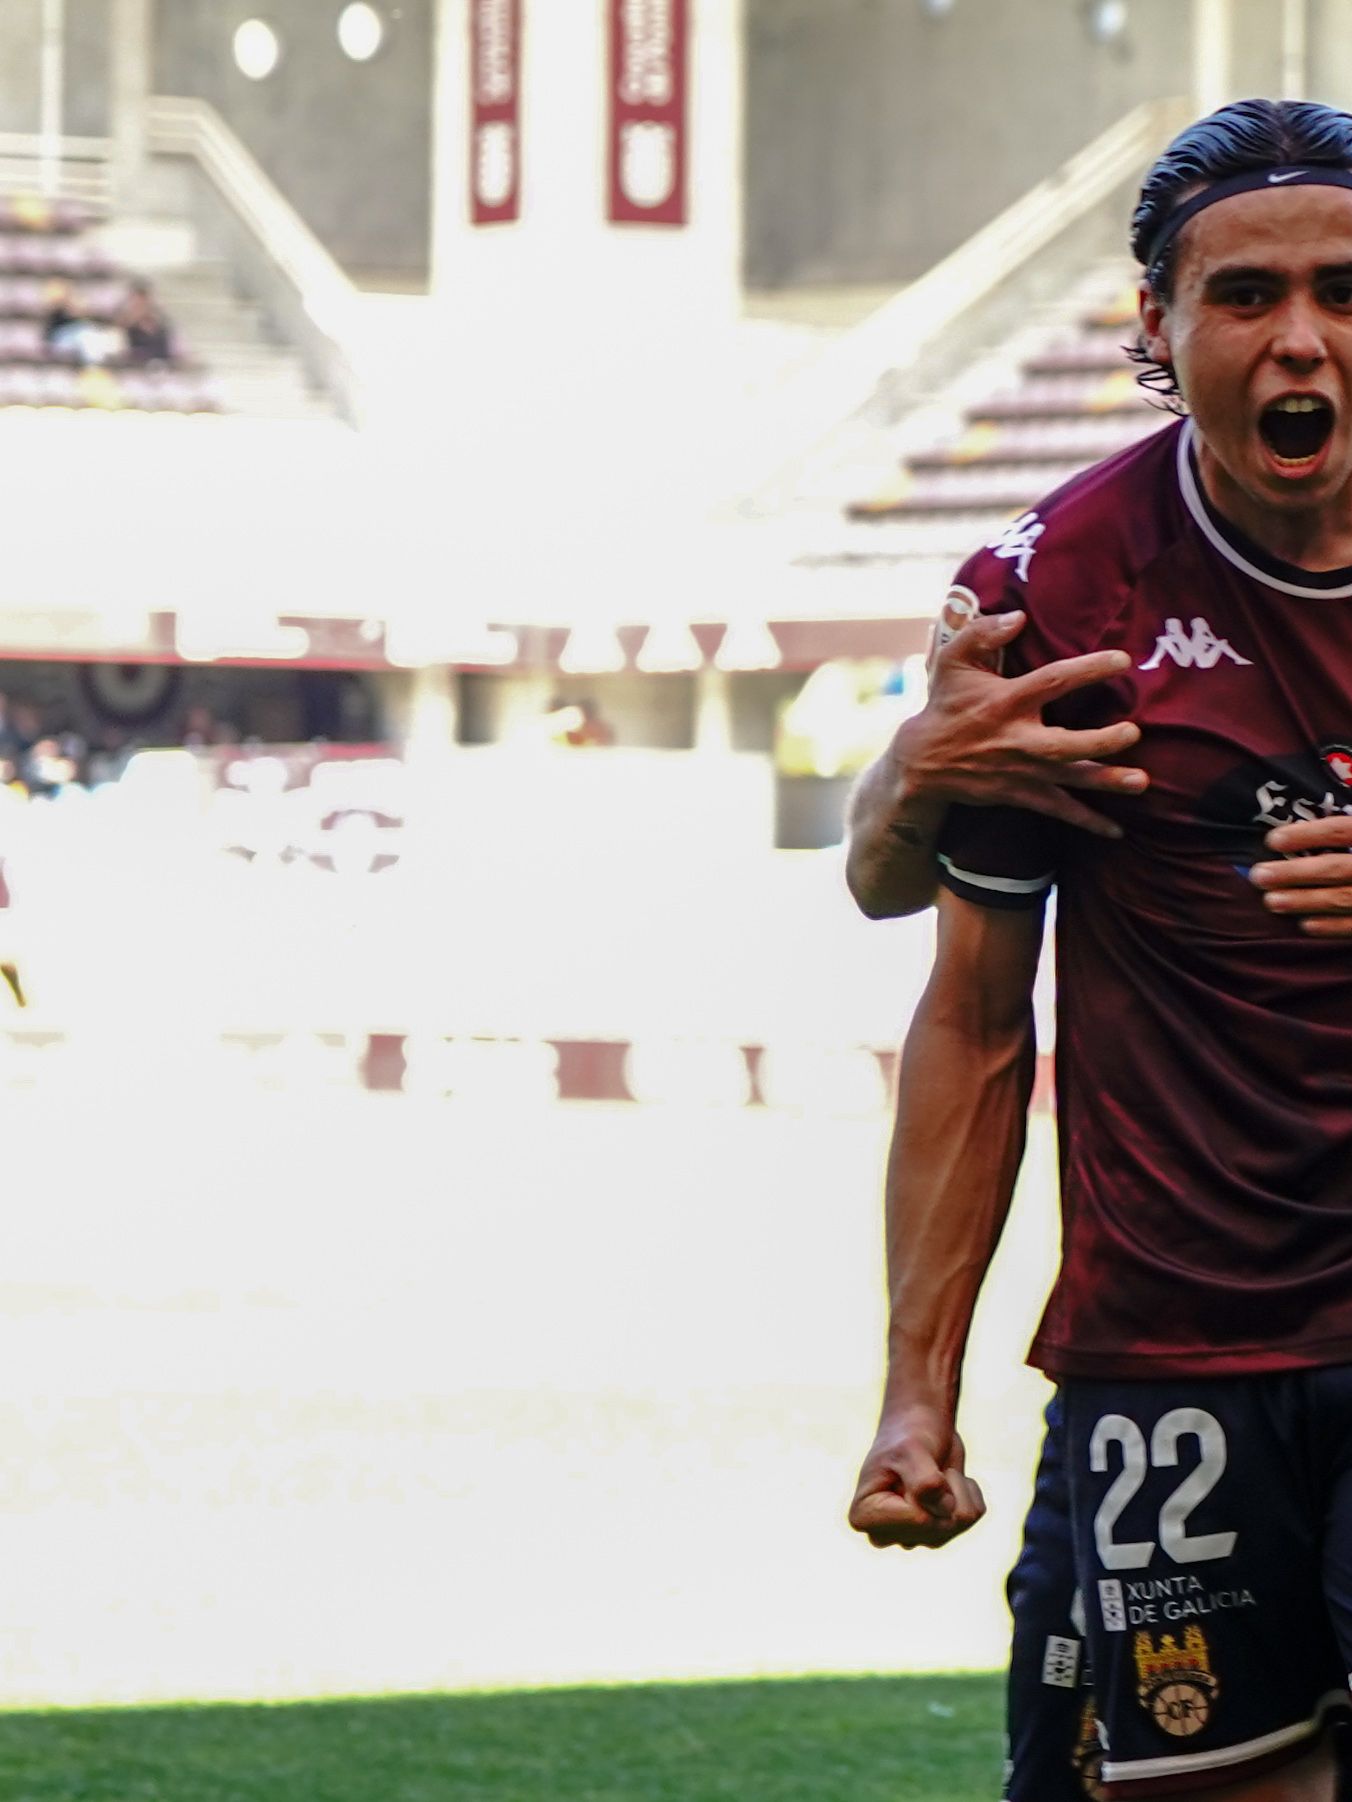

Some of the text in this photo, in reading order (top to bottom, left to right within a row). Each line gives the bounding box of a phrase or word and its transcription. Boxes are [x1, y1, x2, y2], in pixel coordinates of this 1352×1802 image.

[1089, 1406, 1239, 1571] 22
[1125, 1575, 1204, 1601] XUNTA
[1128, 1588, 1258, 1625] DE GALICIA
